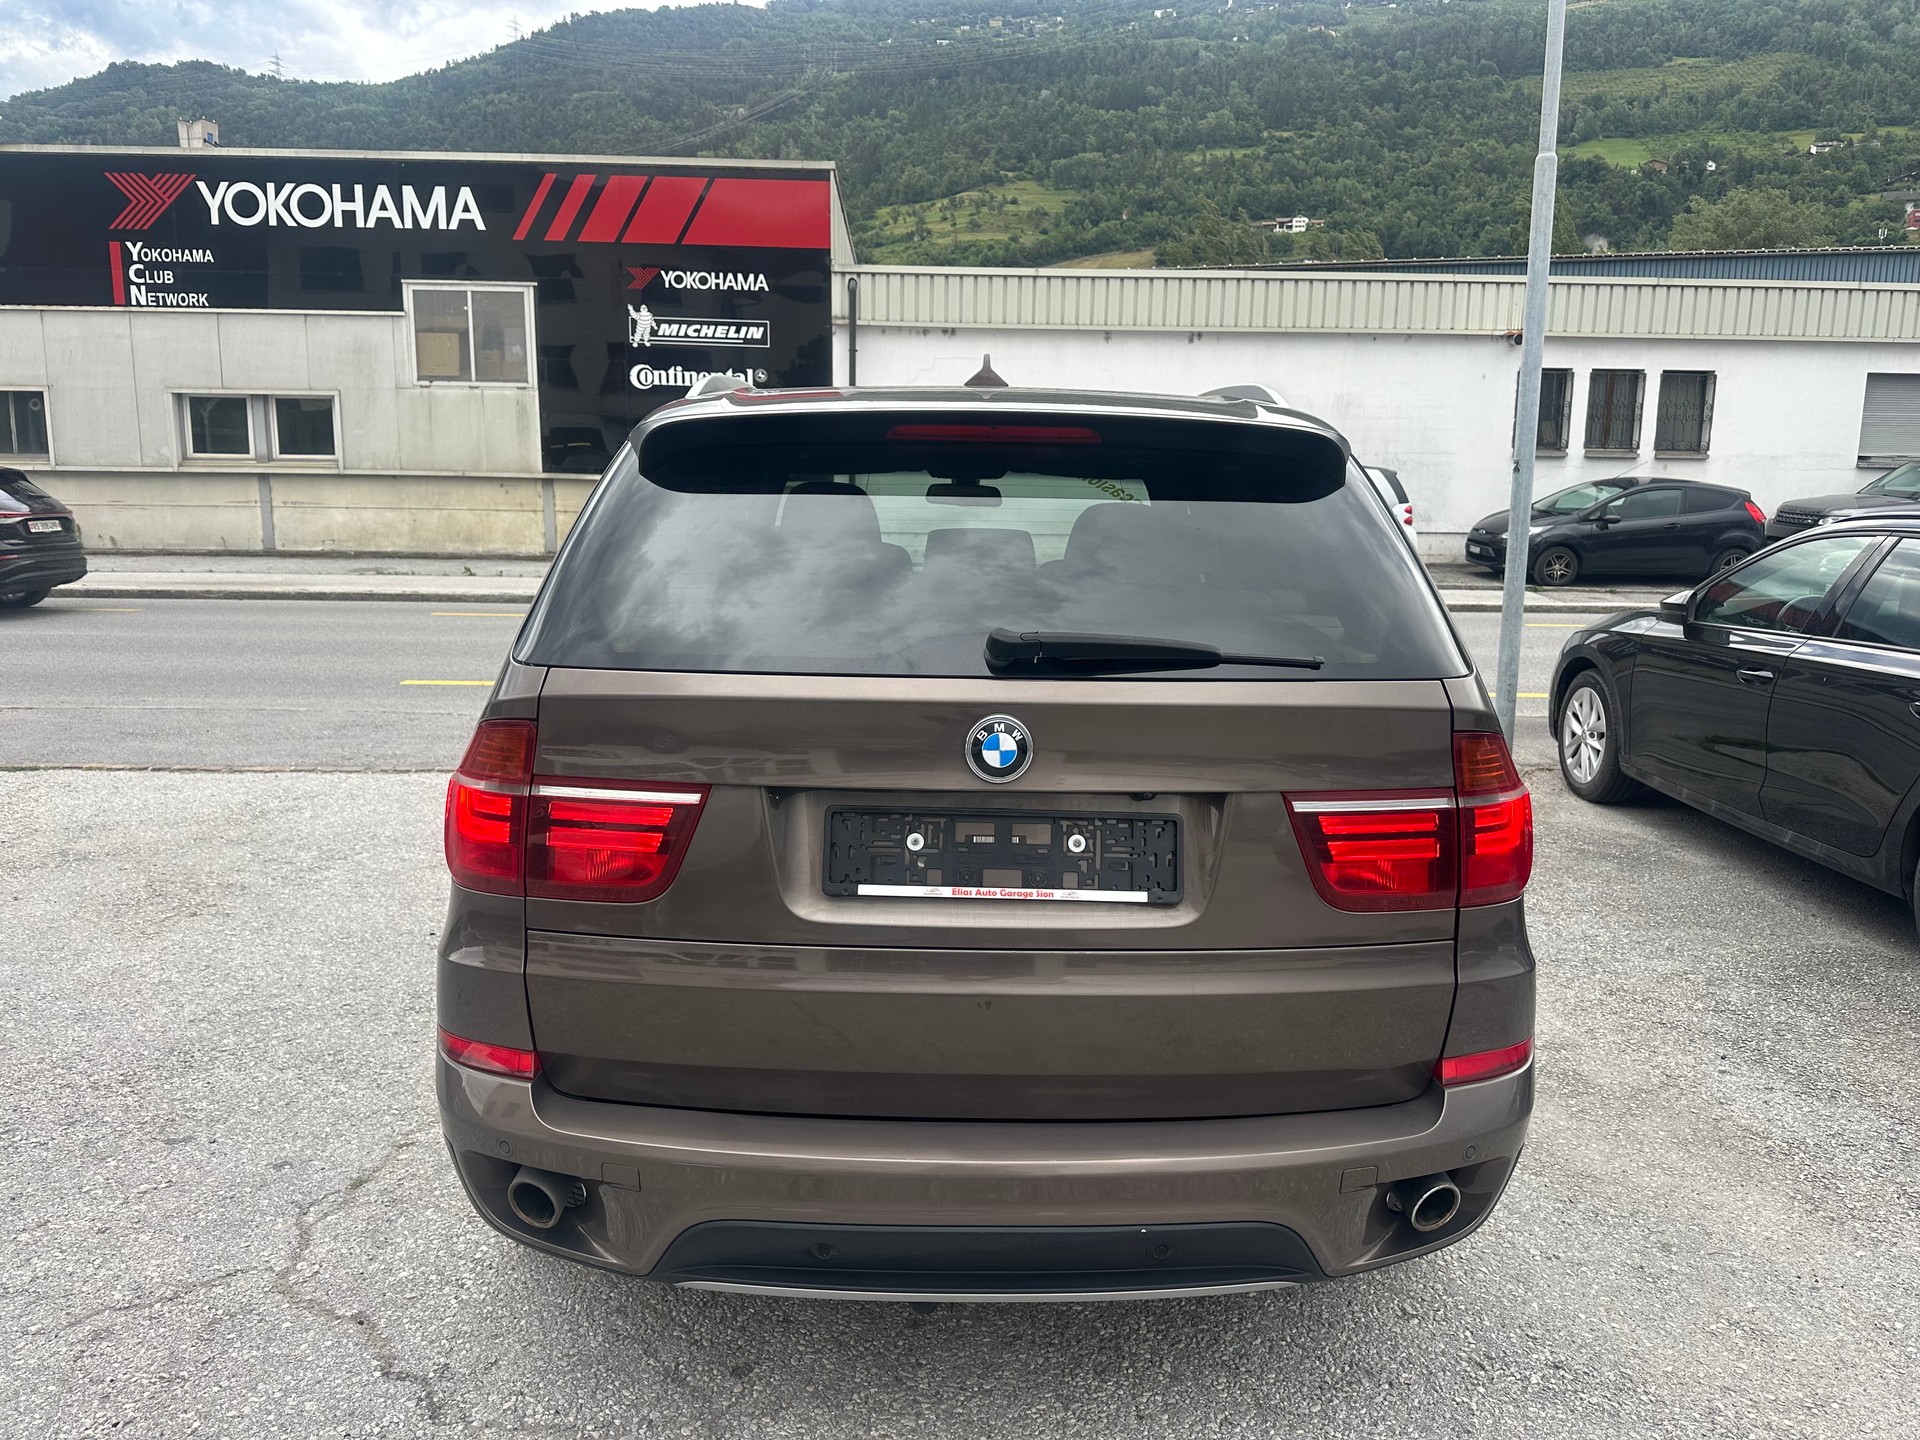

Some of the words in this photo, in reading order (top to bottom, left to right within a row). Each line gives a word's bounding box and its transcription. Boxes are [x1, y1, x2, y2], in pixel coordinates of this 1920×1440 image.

[195, 180, 486, 231] YOKOHAMA
[125, 241, 215, 263] YOKOHAMA
[128, 263, 174, 284] CLUB
[660, 270, 769, 291] YOKOHAMA
[130, 285, 210, 307] NETWORK
[657, 323, 764, 339] MICHELIN
[976, 723, 1023, 742] BMW
[951, 887, 973, 897] Elias
[975, 888, 998, 897] Auto
[999, 889, 1034, 899] Garage
[1036, 889, 1055, 898] Sion
